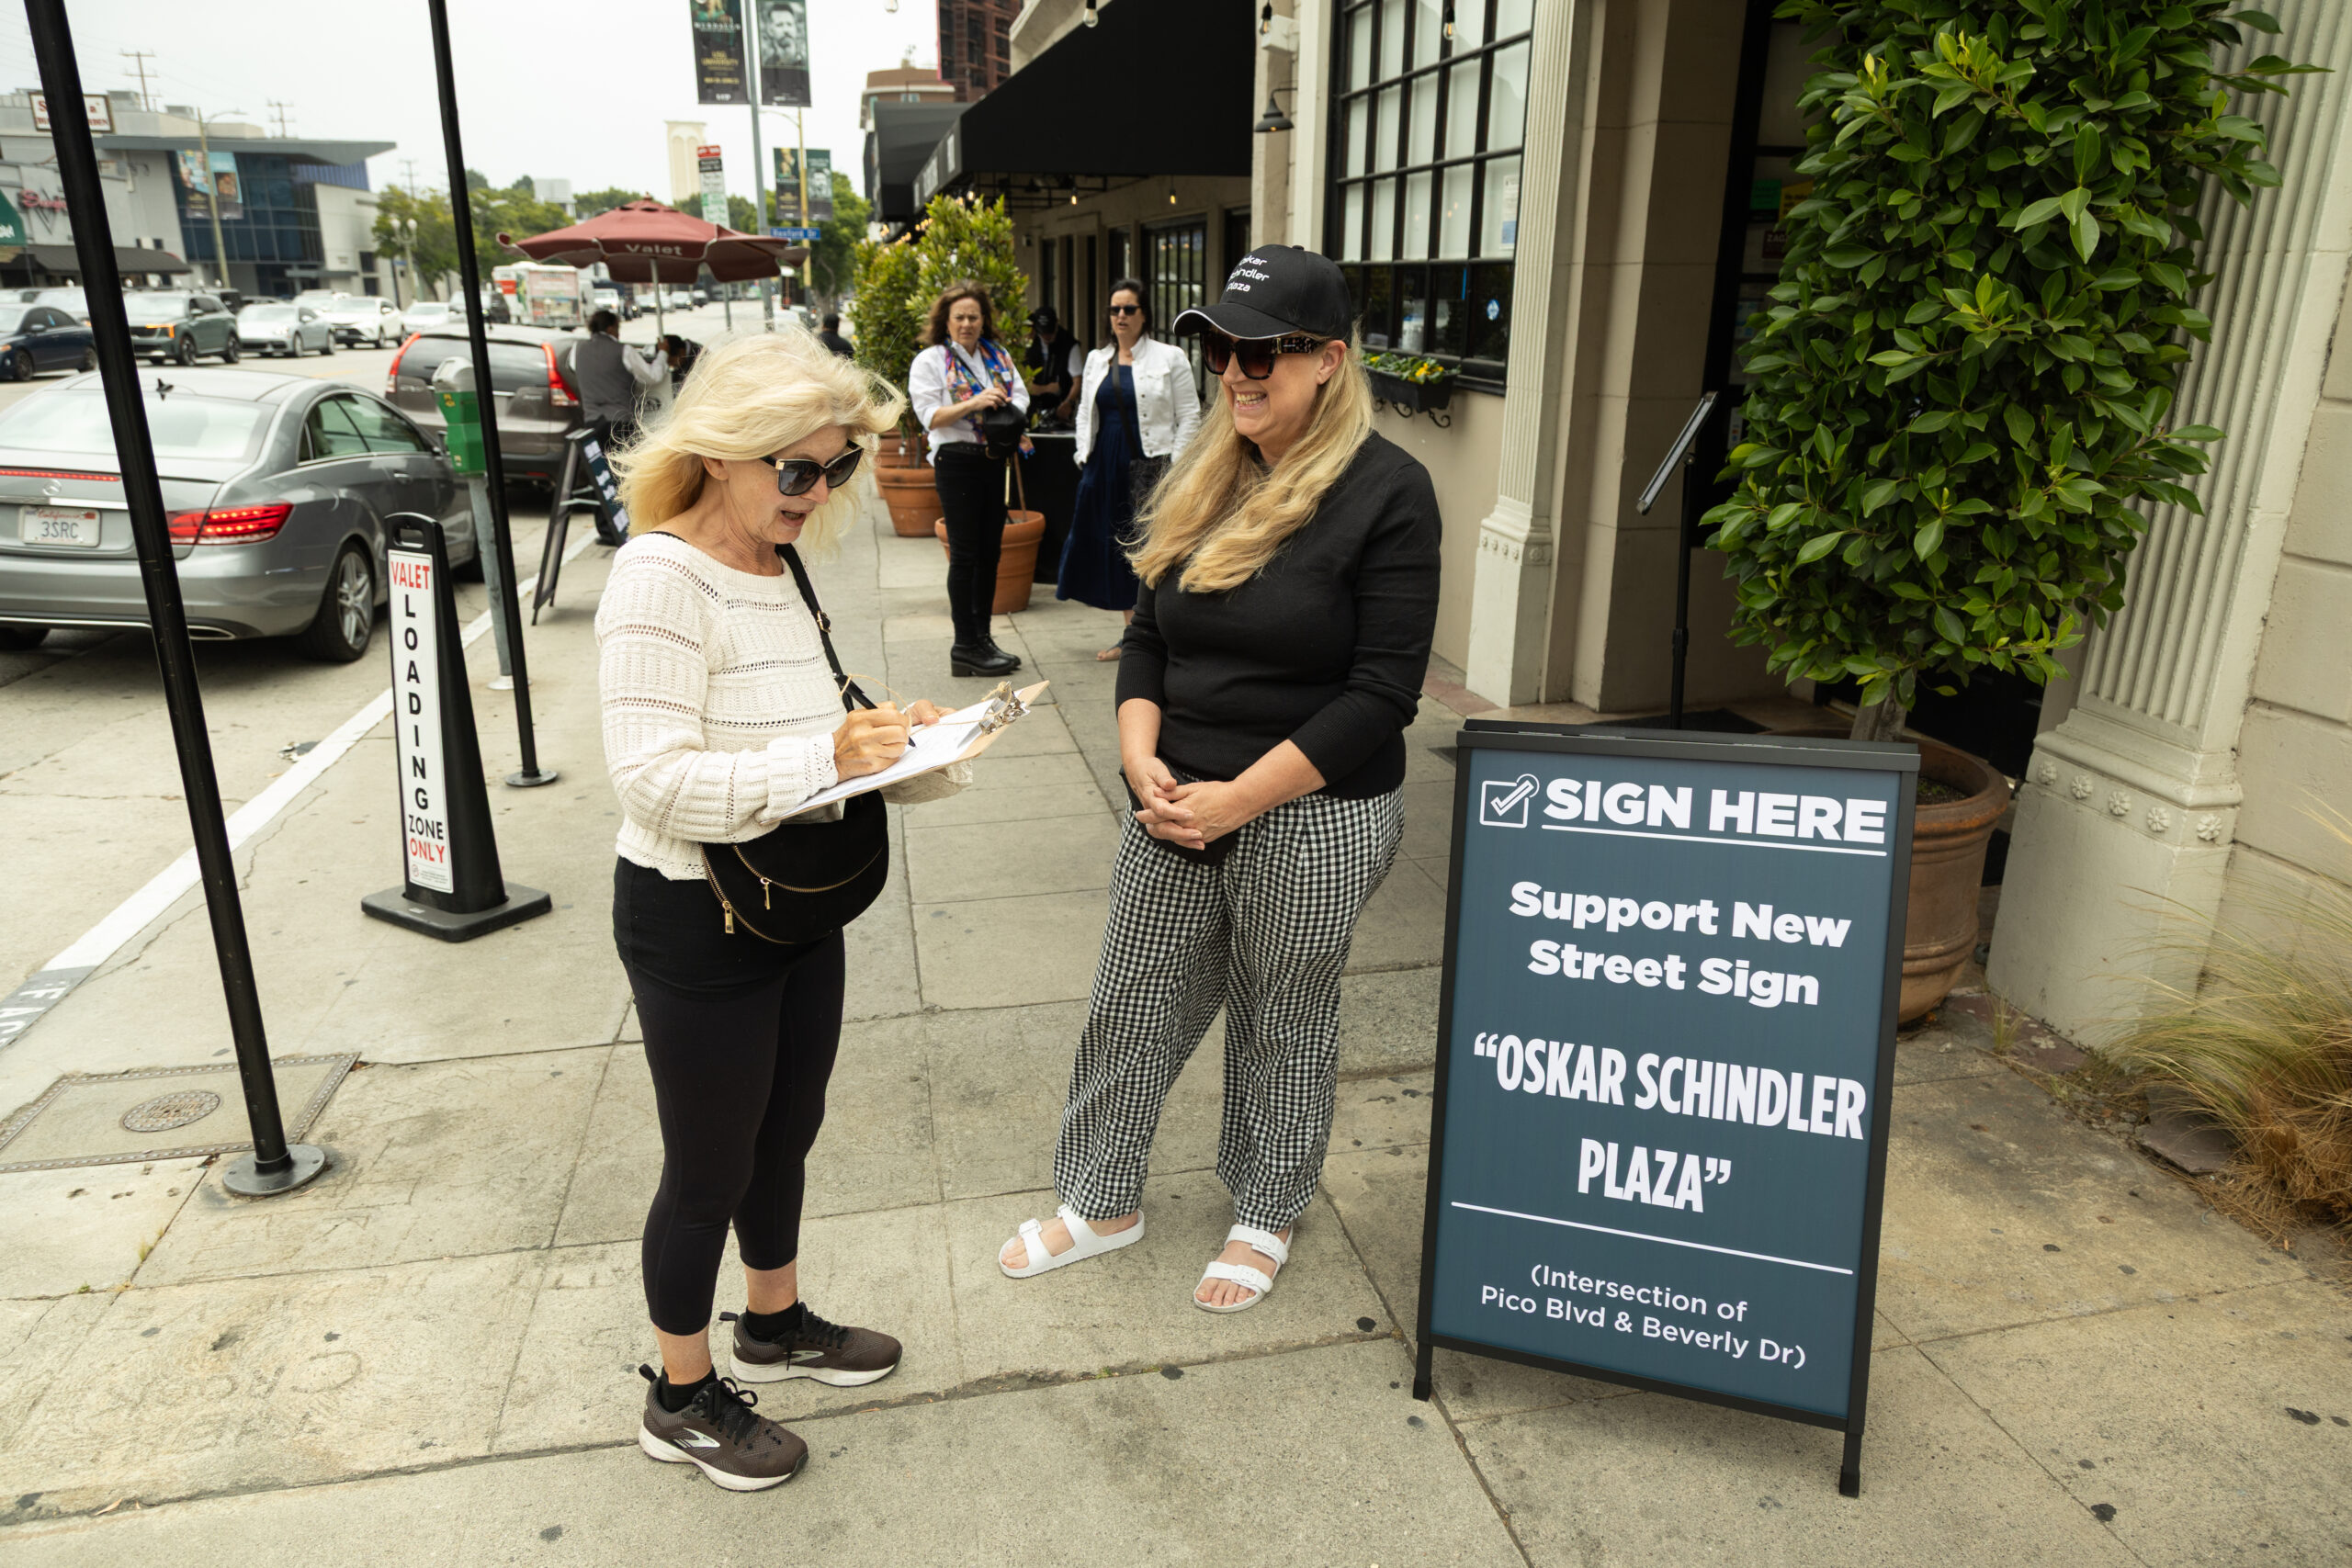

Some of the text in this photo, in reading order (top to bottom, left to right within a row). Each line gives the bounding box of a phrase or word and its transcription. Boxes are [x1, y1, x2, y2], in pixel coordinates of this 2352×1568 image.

[626, 243, 683, 256] Valet
[41, 521, 79, 538] 3SRC
[390, 559, 430, 591] VALET
[404, 592, 429, 811] LOADING
[408, 814, 444, 840] ZONE
[1543, 777, 1888, 844] SIGN HERE
[409, 837, 446, 864] ONLY
[1508, 881, 1852, 948] Support New
[1527, 939, 1819, 1009] Street Sign
[1474, 1032, 1867, 1140] “OSKAR SCHINDLER
[1577, 1137, 1732, 1213] PLAZA”
[1531, 1264, 1748, 1322] (Intersection of
[1481, 1284, 1806, 1370] Pico Blvd & Beverly Dr)
